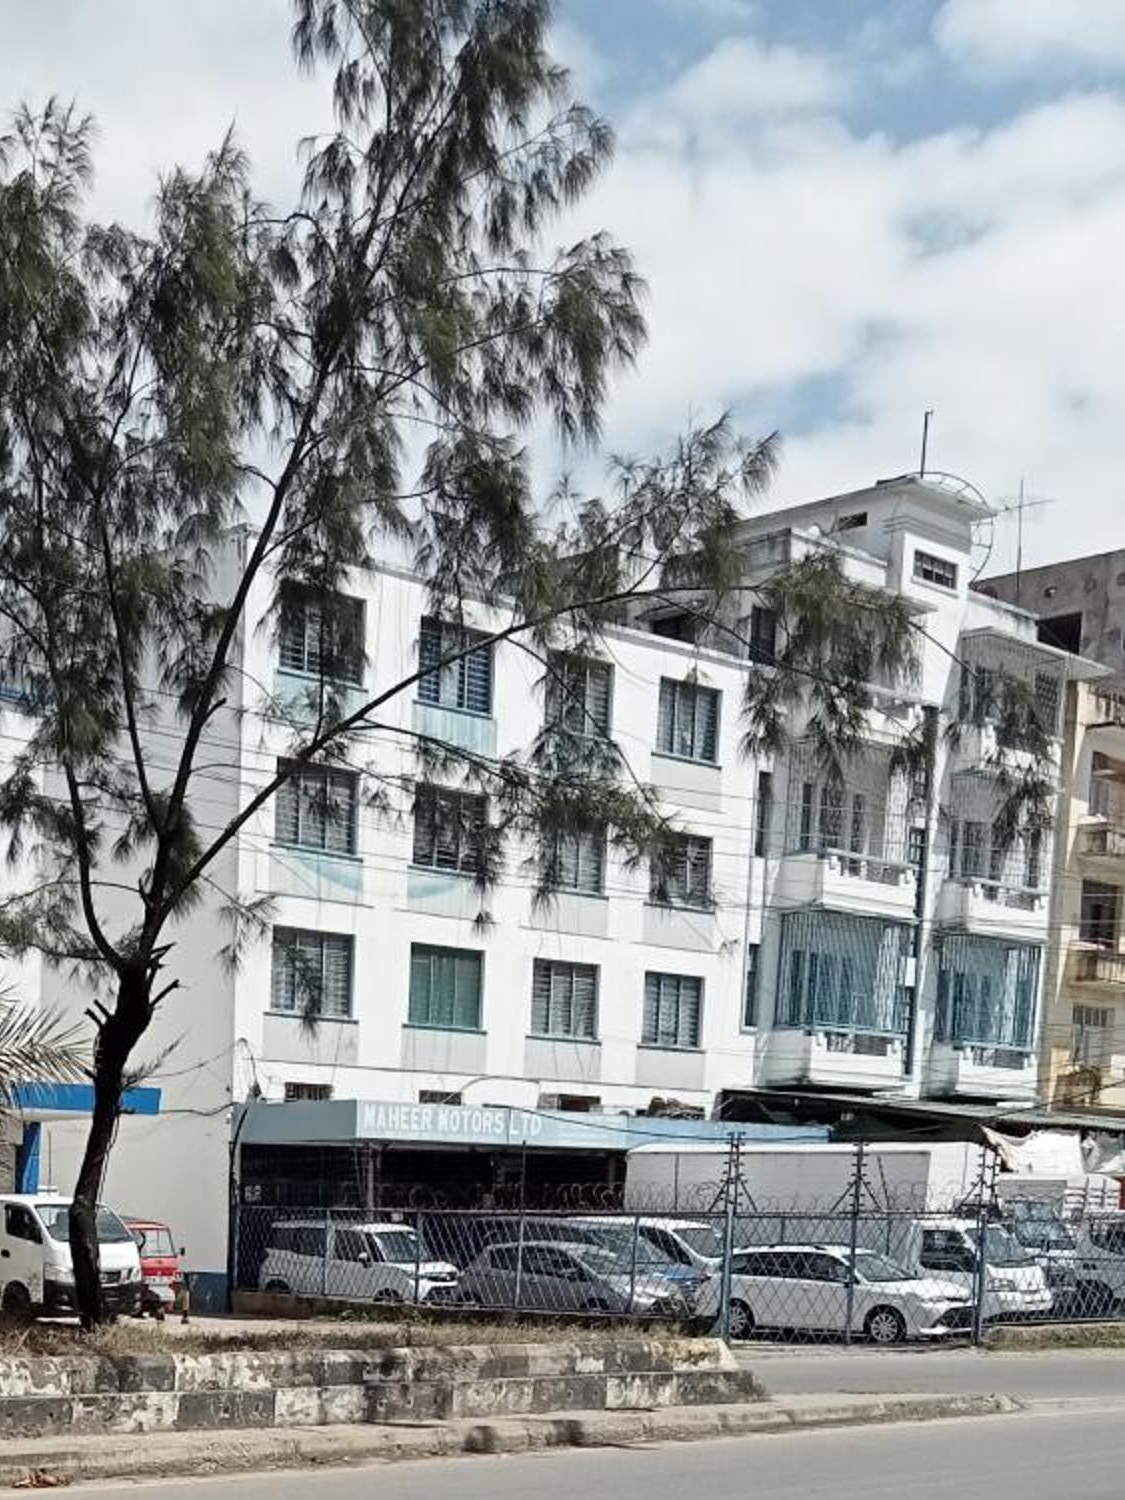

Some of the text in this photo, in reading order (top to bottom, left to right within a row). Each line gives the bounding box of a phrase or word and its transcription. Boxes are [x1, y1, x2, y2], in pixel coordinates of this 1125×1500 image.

[364, 1104, 543, 1136] MAHEER MOTORS LTD
